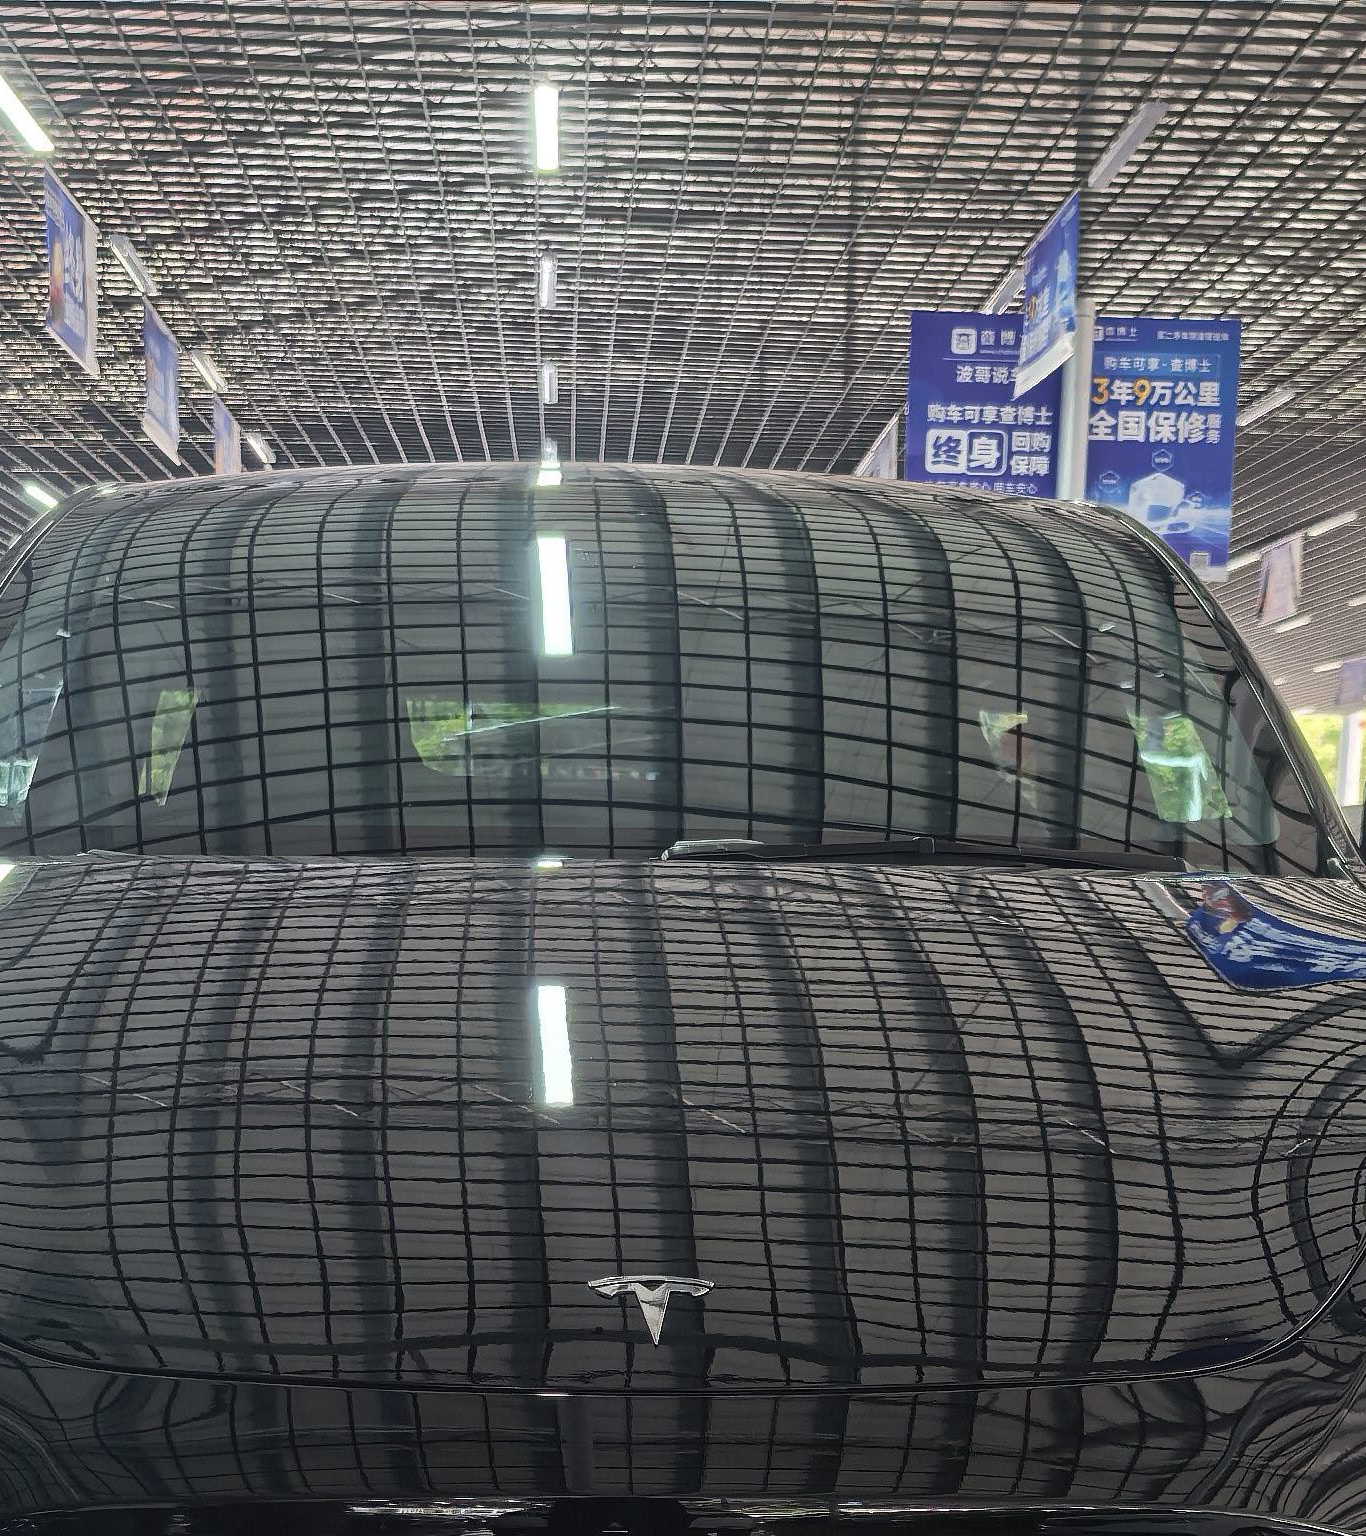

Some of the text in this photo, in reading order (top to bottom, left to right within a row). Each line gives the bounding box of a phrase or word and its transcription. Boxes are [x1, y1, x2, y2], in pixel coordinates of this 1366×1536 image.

[1091, 377, 1221, 407] 3年9万公里
[927, 404, 1053, 425] 购车可享查博士
[1088, 409, 1206, 444] 全国保修
[931, 435, 1001, 469] 终身
